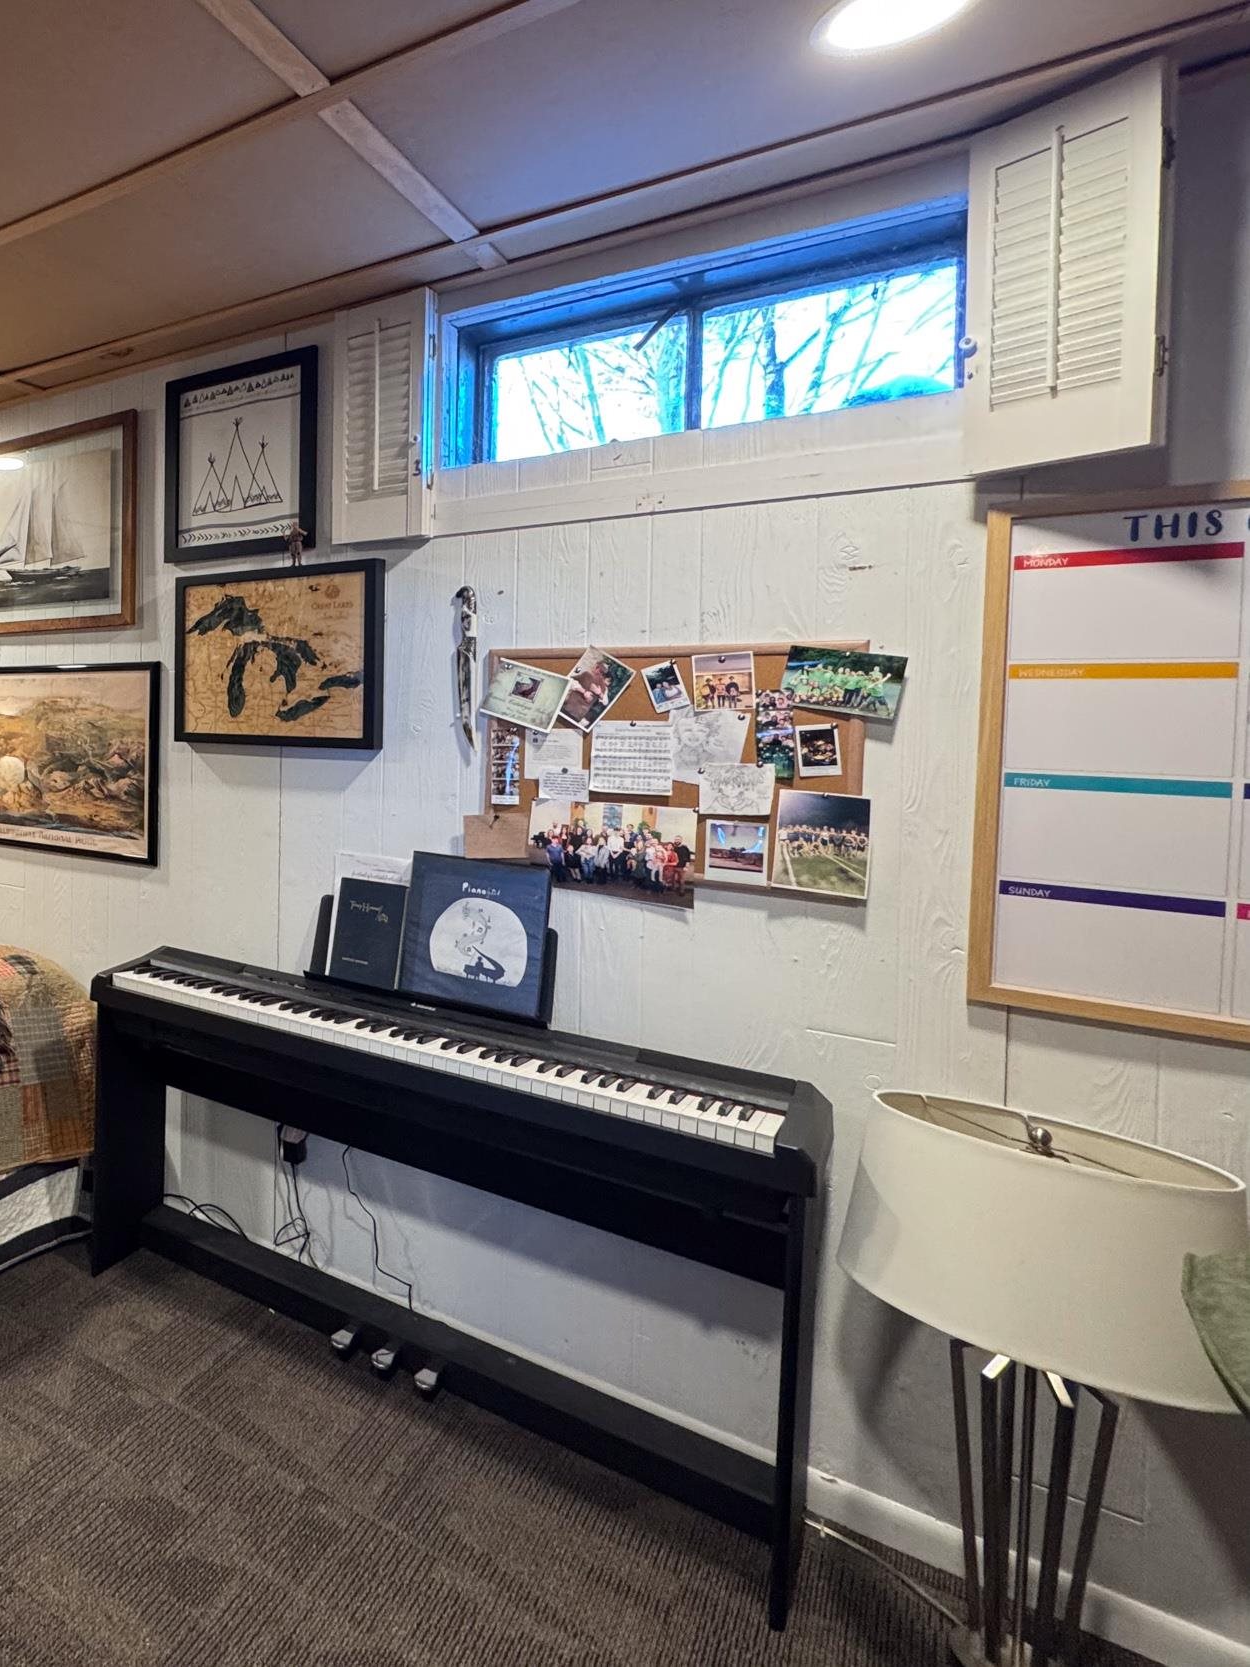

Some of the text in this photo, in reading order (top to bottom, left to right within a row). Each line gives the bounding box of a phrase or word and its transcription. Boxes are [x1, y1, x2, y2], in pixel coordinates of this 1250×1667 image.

[1123, 509, 1224, 542] THIS
[1023, 556, 1069, 569] MONDAY
[1013, 777, 1051, 787] FRIDAY
[1008, 885, 1052, 898] SUNDAY
